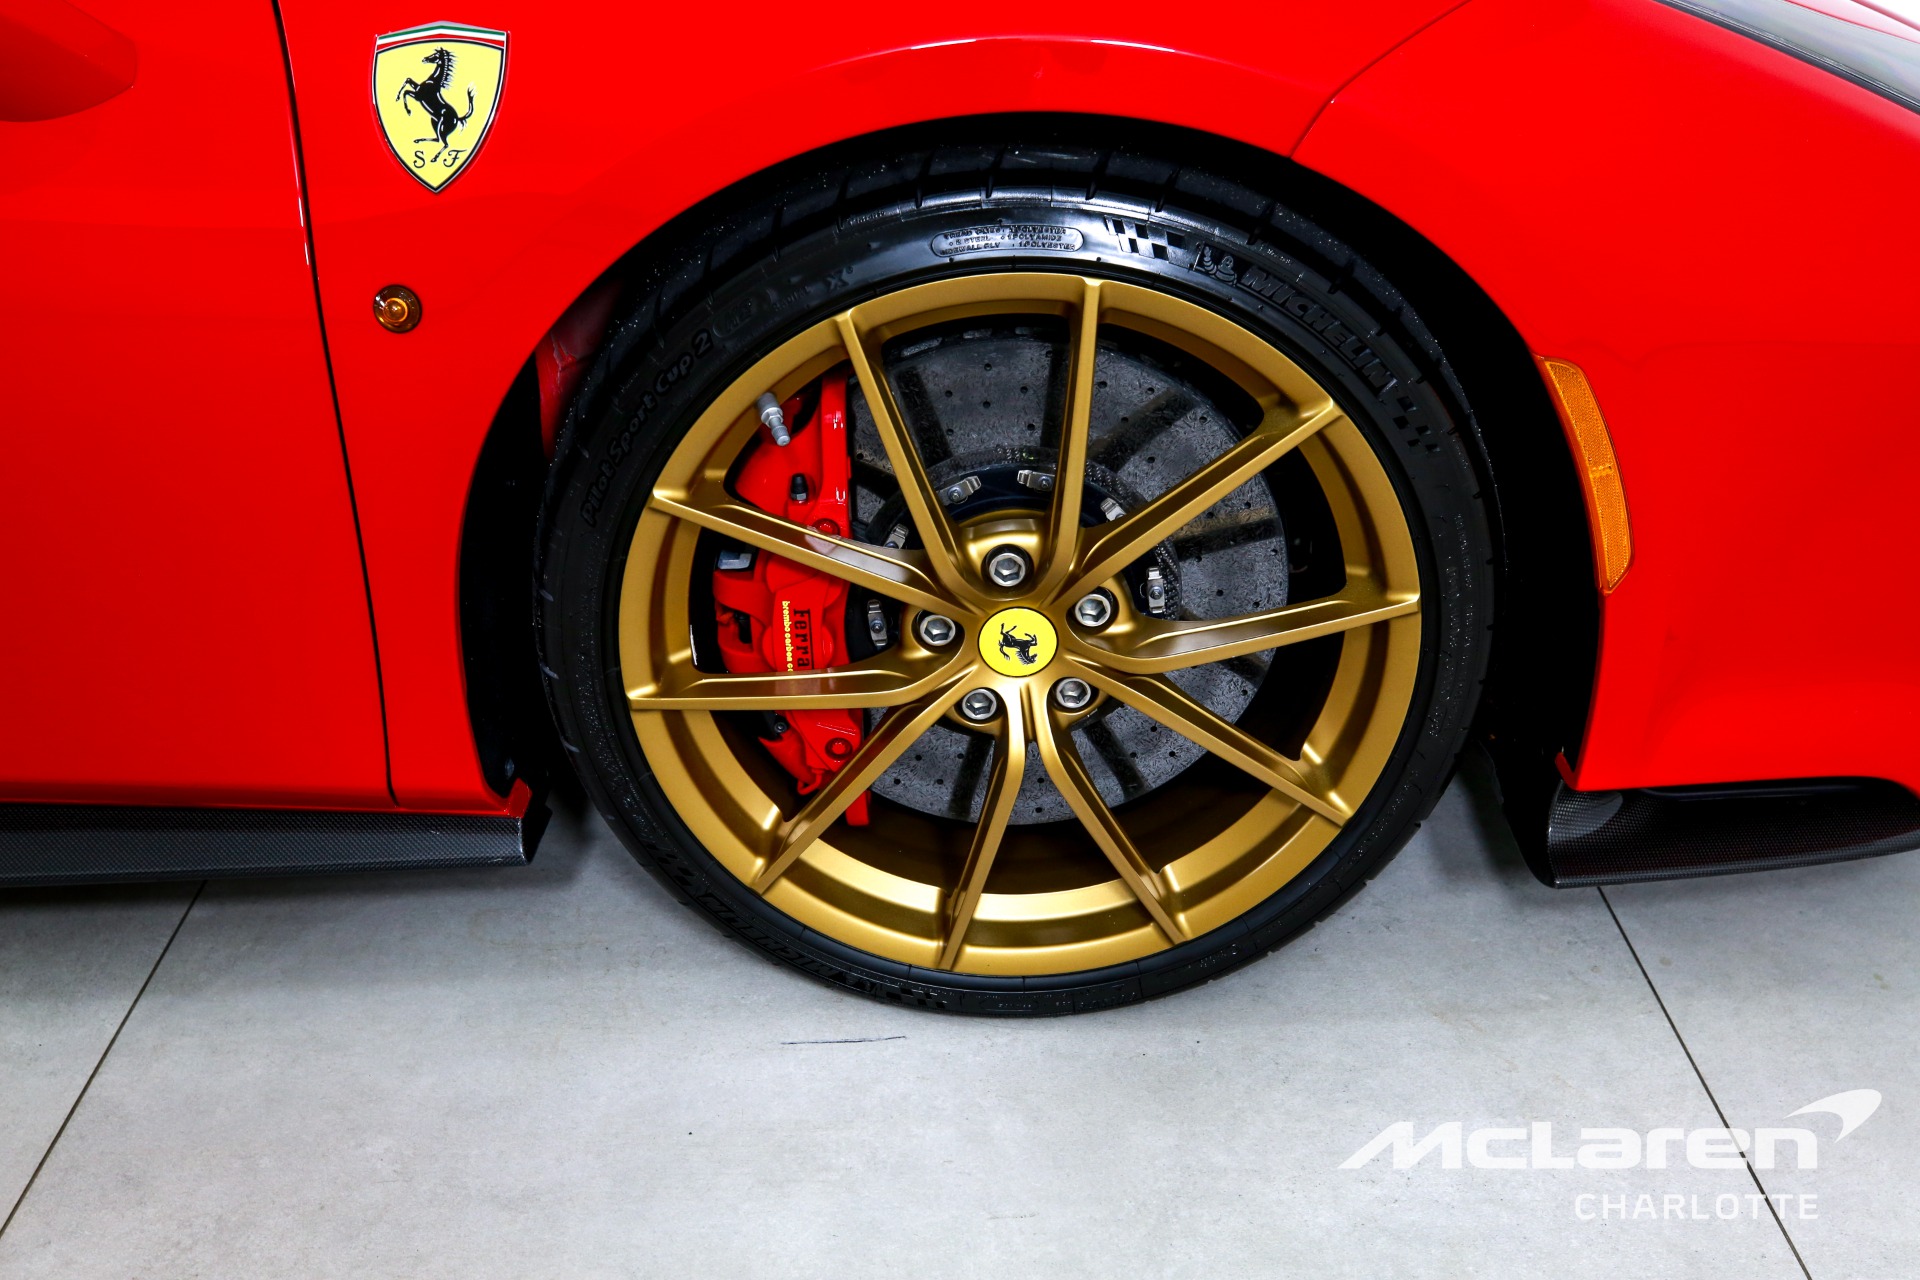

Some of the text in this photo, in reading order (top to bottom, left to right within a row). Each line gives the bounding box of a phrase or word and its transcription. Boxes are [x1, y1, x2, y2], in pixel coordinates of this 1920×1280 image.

[413, 149, 468, 169] S F
[1239, 264, 1396, 391] MICHELIN
[579, 459, 617, 528] Pilot
[607, 390, 659, 468] Sport
[653, 351, 695, 397] Cup
[692, 327, 715, 361] 2
[782, 601, 792, 632] brembo
[794, 608, 814, 669] Ferra
[784, 633, 794, 662] carbon
